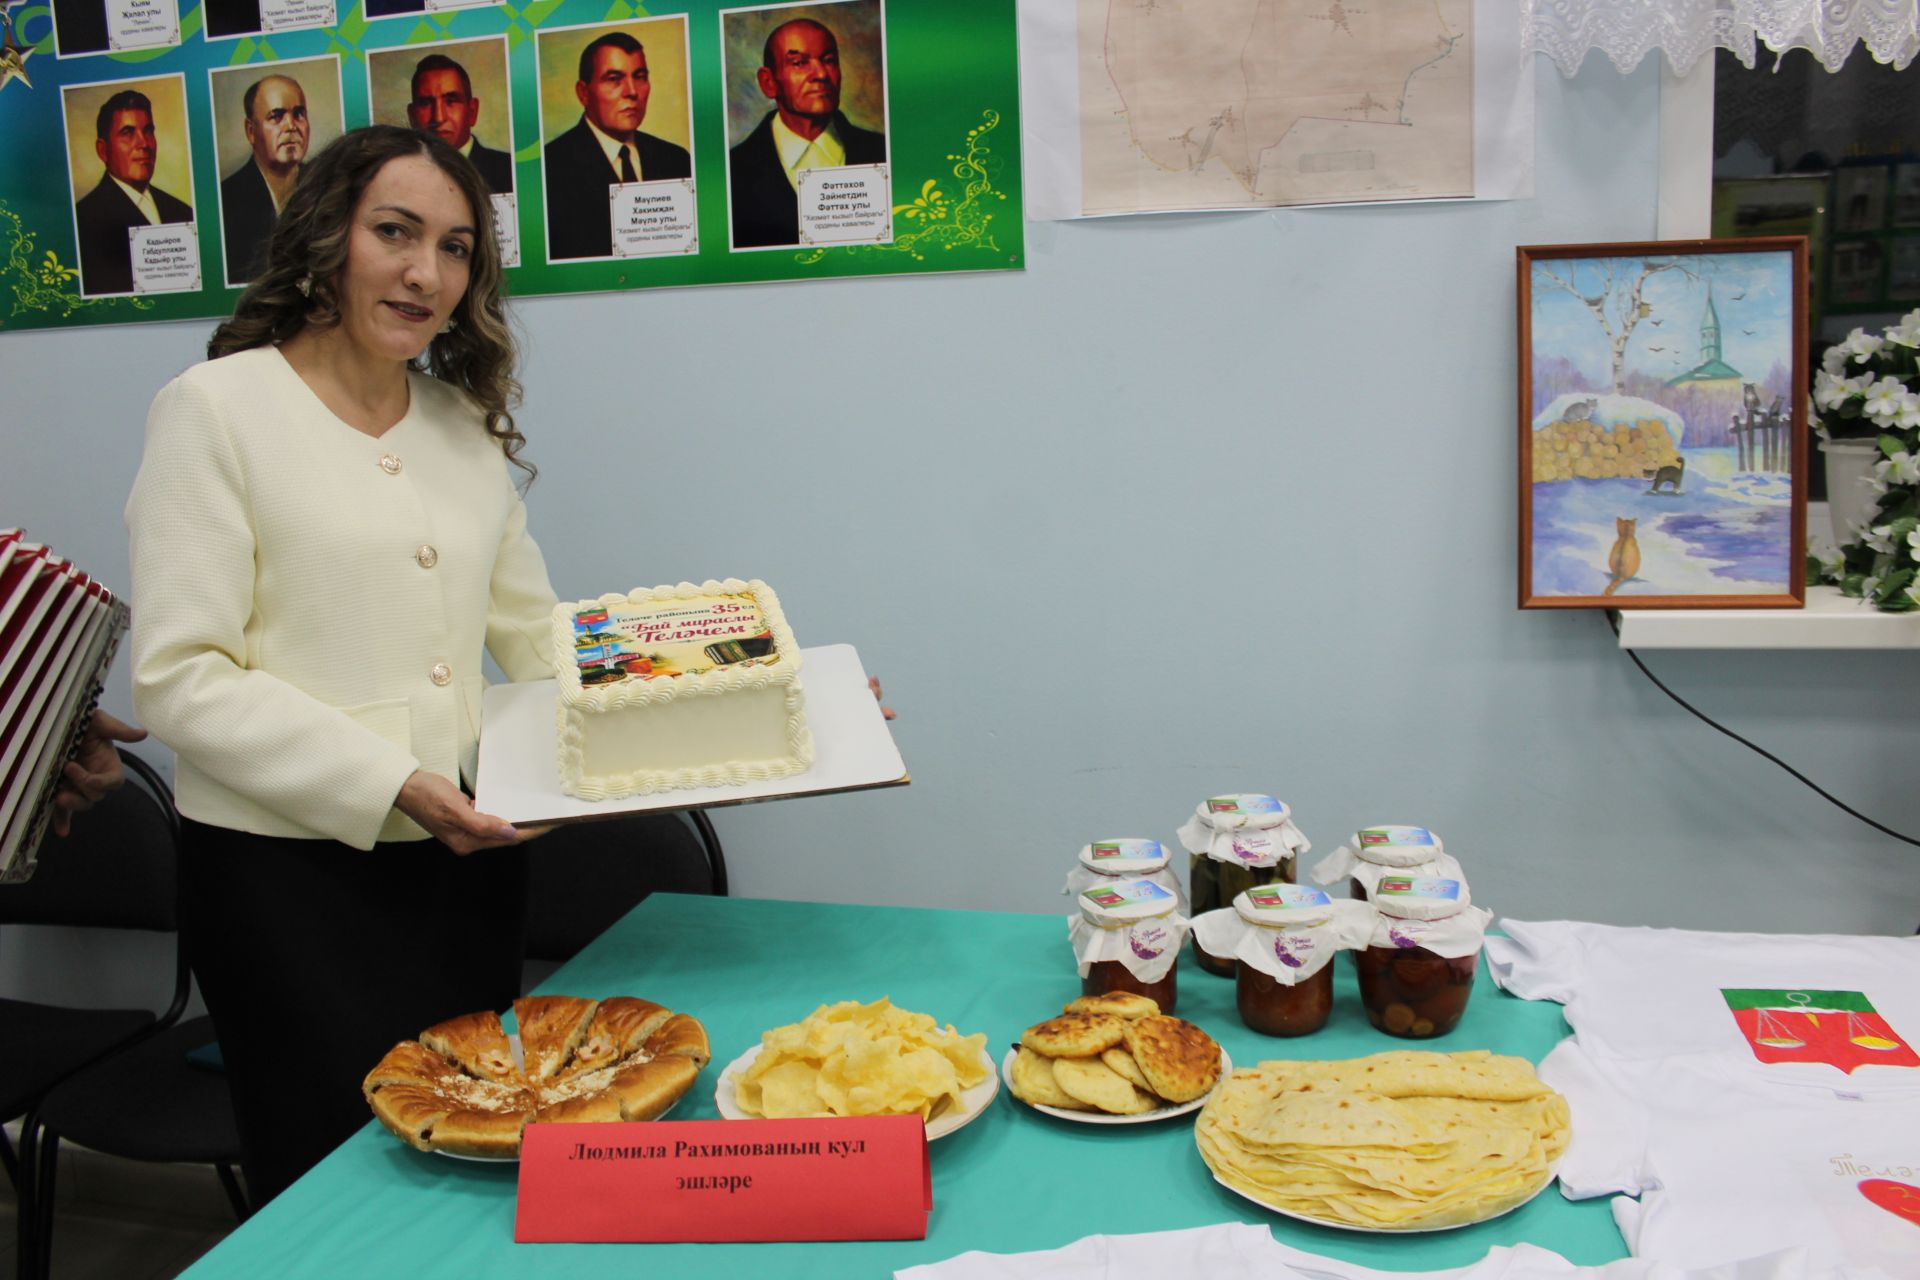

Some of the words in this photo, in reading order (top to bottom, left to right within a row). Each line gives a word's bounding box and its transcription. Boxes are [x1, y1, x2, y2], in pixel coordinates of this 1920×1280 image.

[852, 202, 871, 211] улы
[660, 215, 677, 225] улы
[712, 603, 741, 615] 35
[677, 614, 756, 628] мираслы
[637, 625, 746, 643] Теләчем
[569, 1142, 667, 1162] Людмила
[674, 1139, 822, 1159] Рахимованың
[827, 1139, 866, 1159] кул
[1829, 1153, 1920, 1178] Телә
[675, 1174, 753, 1193] эшләре
